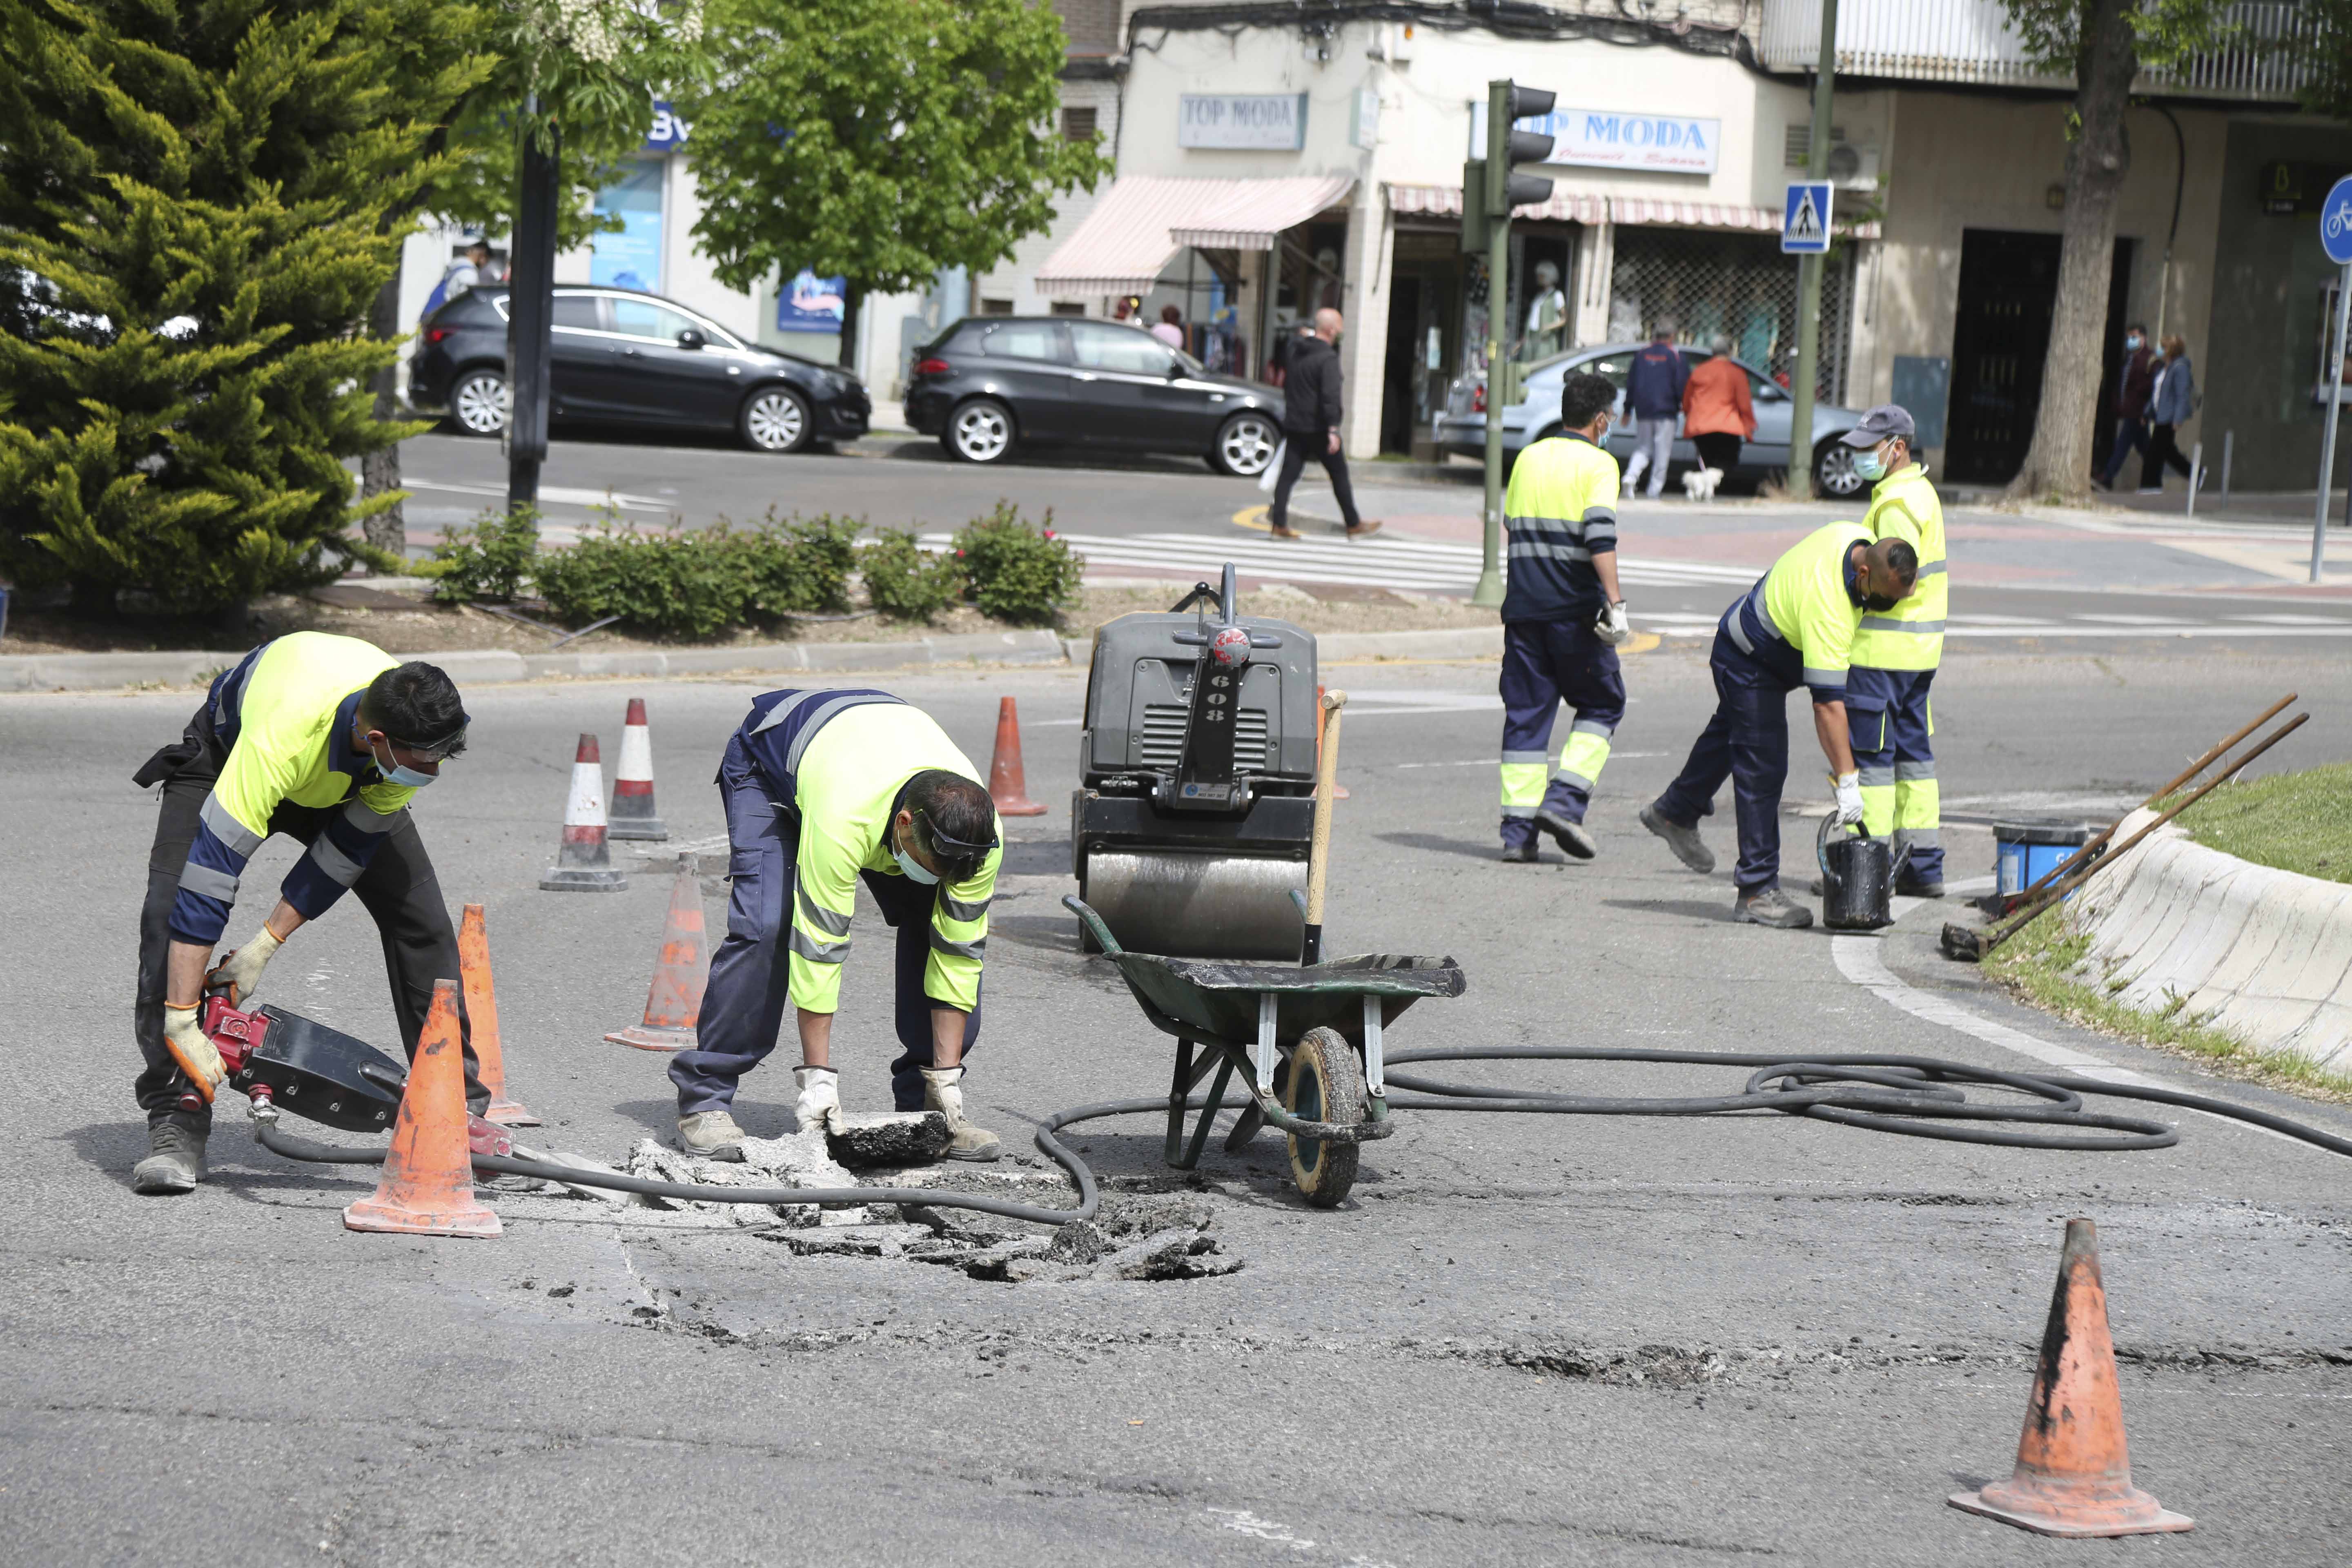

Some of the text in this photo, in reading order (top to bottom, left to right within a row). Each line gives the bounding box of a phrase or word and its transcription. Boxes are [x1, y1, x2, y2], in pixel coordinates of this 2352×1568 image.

[1185, 99, 1292, 127] TOP MODA
[1585, 114, 1707, 150] MODA
[1206, 676, 1229, 722] 608
